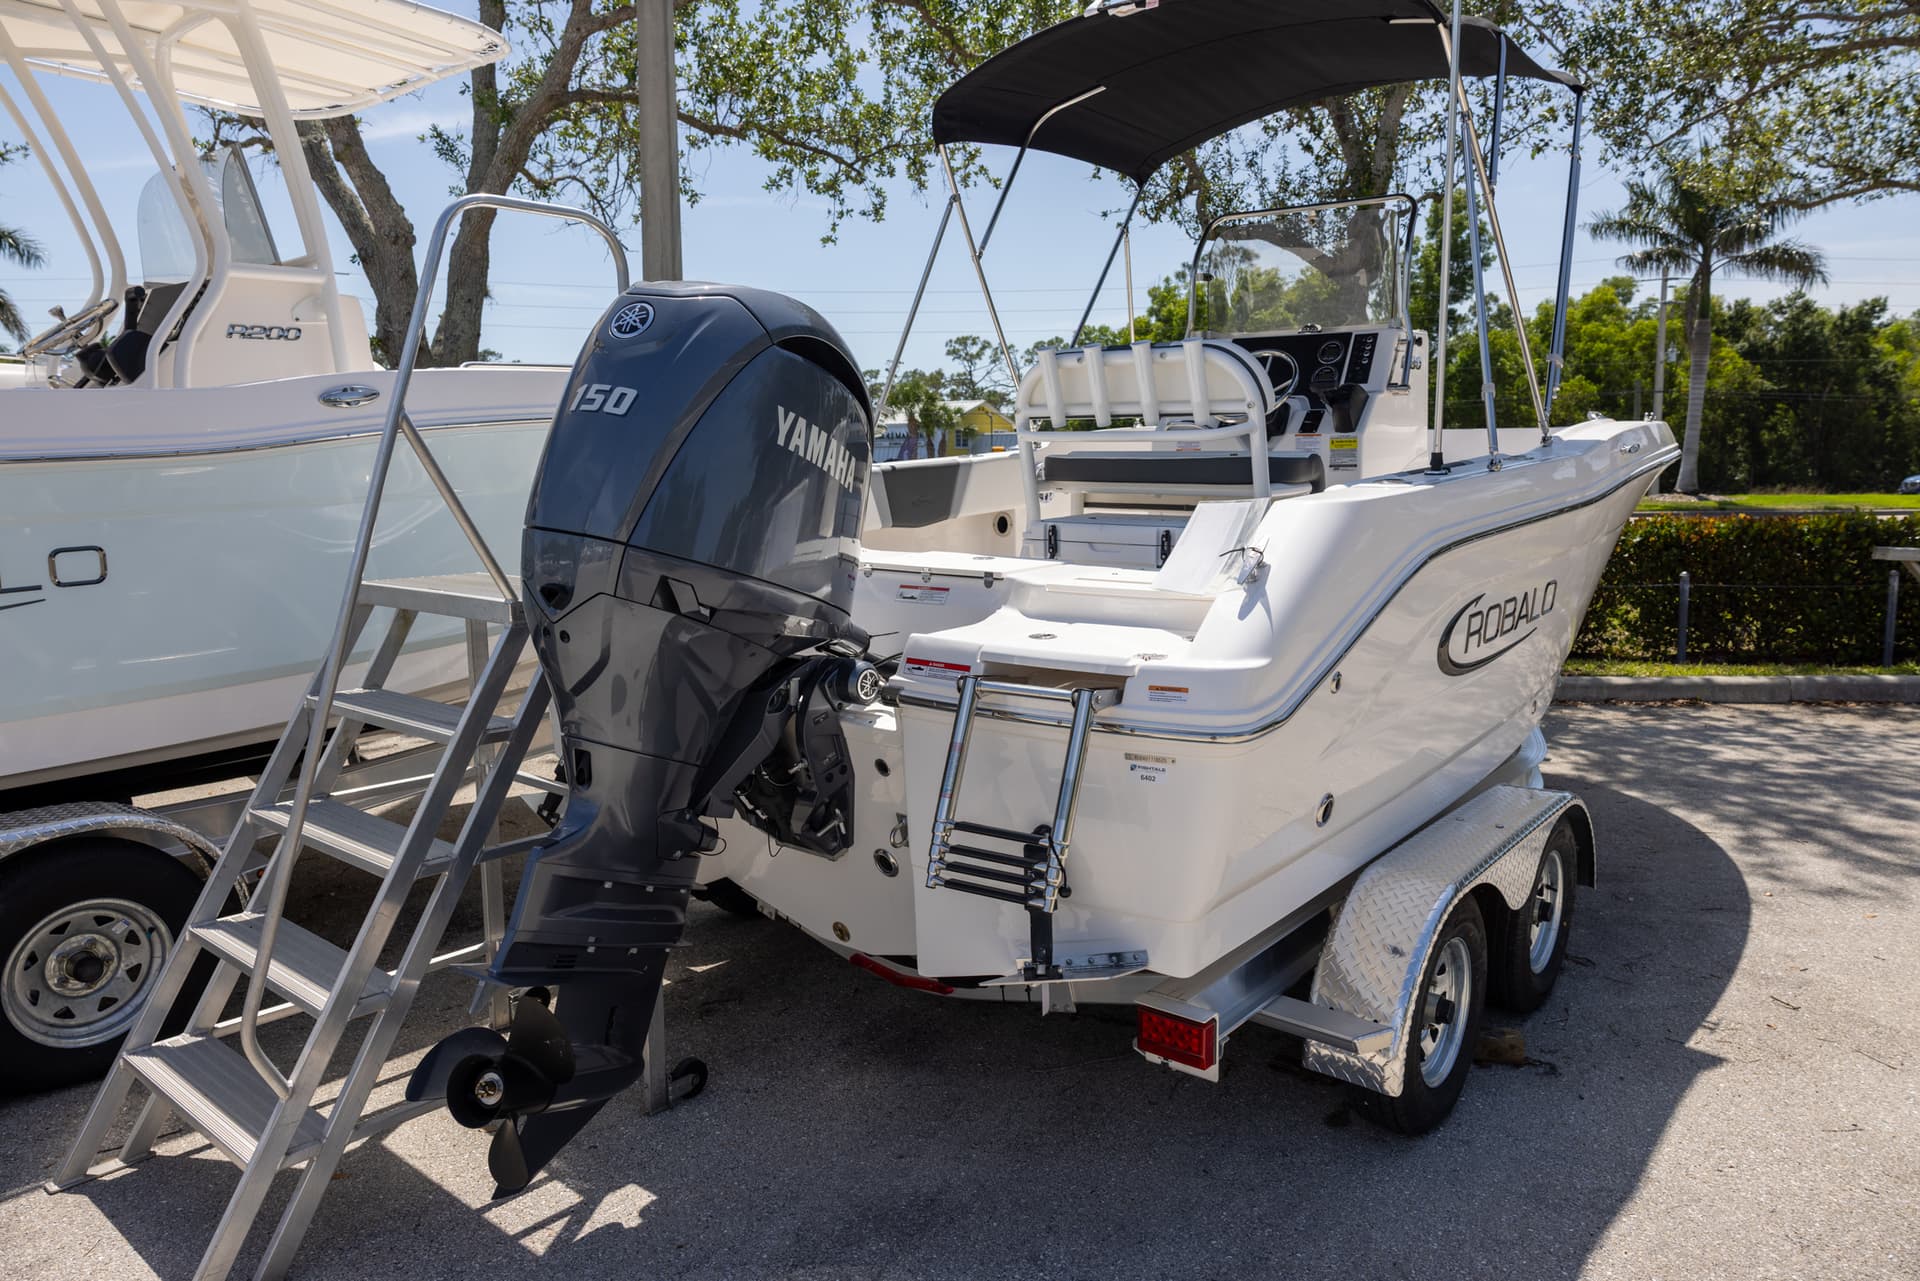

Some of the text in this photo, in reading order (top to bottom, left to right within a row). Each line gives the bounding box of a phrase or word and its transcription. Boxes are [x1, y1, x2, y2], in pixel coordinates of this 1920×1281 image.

[226, 324, 302, 341] R200
[570, 384, 638, 415] 150
[777, 405, 857, 494] YAMAHA
[1464, 579, 1558, 655] ROBALO
